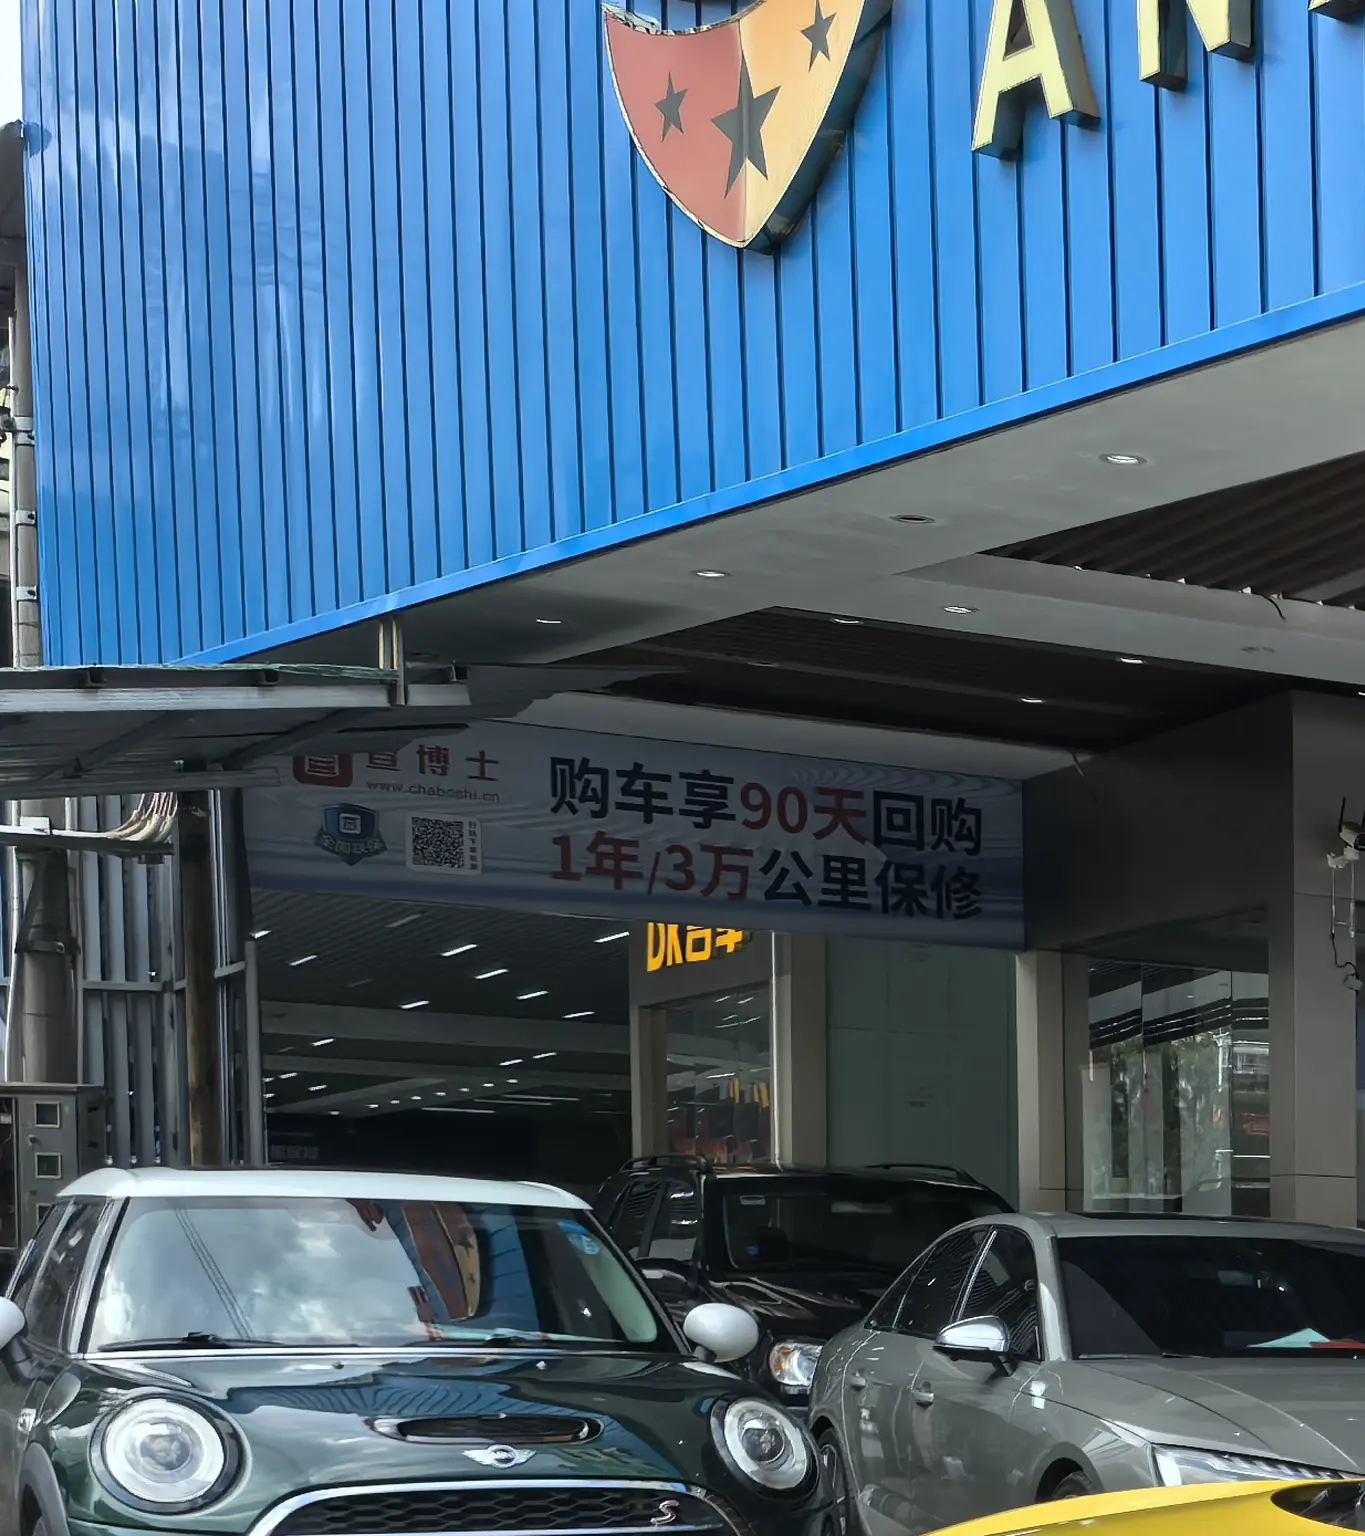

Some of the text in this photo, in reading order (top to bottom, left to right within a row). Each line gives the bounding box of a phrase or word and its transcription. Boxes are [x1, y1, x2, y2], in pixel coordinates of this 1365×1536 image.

[366, 780, 500, 803] www.chaboshi.cn
[550, 756, 983, 856] 购车享90天回购
[550, 830, 984, 920] 1年/3万公里保修
[650, 1499, 680, 1525] S
